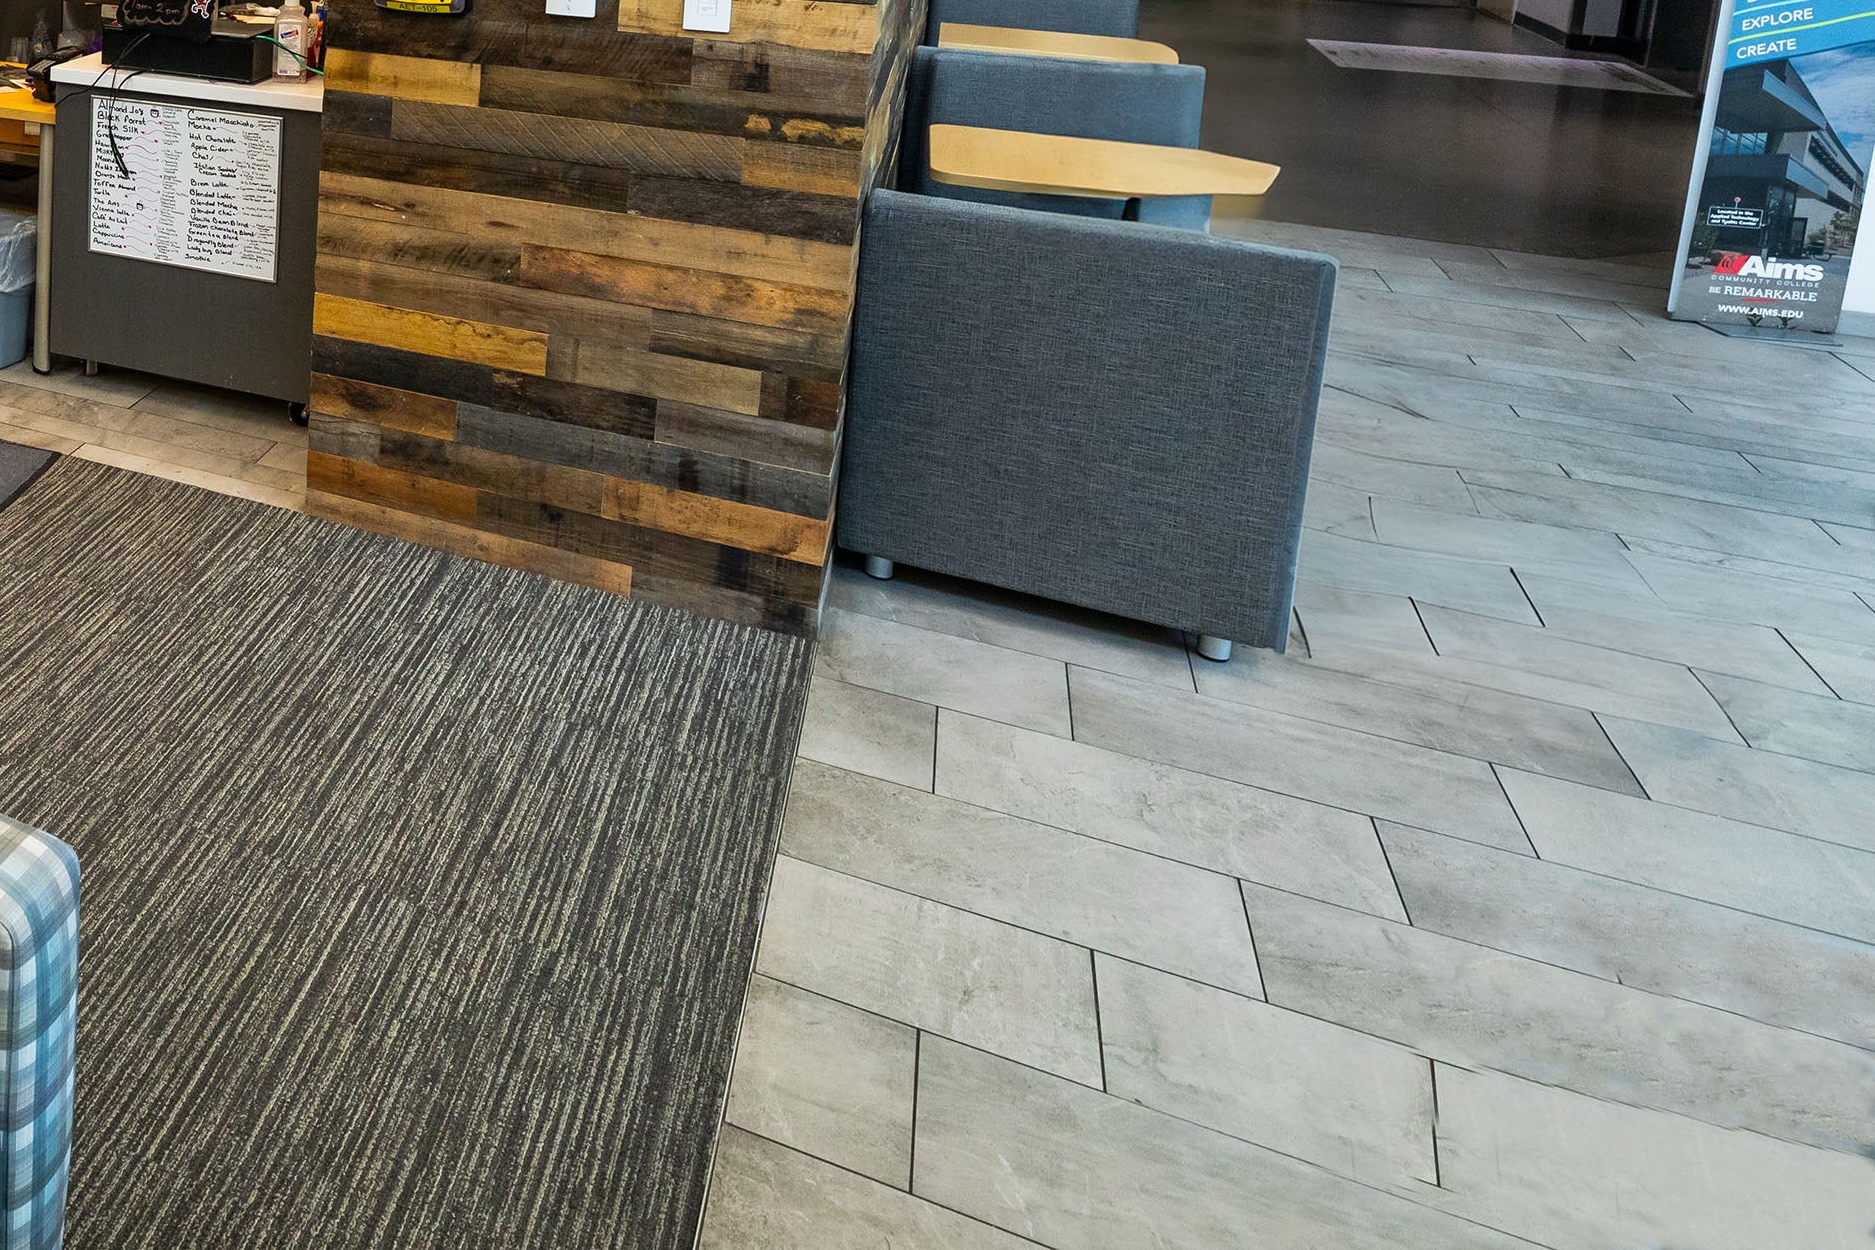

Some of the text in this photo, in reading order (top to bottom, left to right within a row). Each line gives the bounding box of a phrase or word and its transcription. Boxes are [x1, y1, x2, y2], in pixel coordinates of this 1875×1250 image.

[1742, 7, 1814, 31] EXPLORE
[1736, 38, 1797, 59] CREATE
[129, 106, 144, 116] Joy
[187, 110, 217, 123] Caramel
[123, 125, 139, 134] Silk
[188, 121, 211, 130] Mocha
[189, 132, 237, 144] Hot Chocolate
[191, 142, 228, 153] Apple Cider
[193, 162, 216, 171] Italian
[198, 167, 217, 176] Cream
[95, 170, 116, 180] Orange
[93, 178, 116, 188] Toffee
[93, 188, 111, 196] Turtle
[190, 188, 233, 200] Blended Latte
[93, 197, 105, 205] The
[190, 198, 238, 210] Blended Mocha
[92, 204, 115, 213] Vienna
[190, 207, 215, 215] Blended
[190, 214, 211, 223] Vanilla
[93, 221, 111, 230] Latte
[187, 221, 209, 230] Frozen
[187, 235, 234, 249] Dragonfly Blend
[215, 248, 233, 256] Blend
[1737, 255, 1824, 282] Aims
[1710, 274, 1820, 289] COMMUNITY COLLEGE
[1708, 285, 1818, 302] BE REMARKABLE
[1717, 304, 1804, 319] WWW.AIMS.EDU
